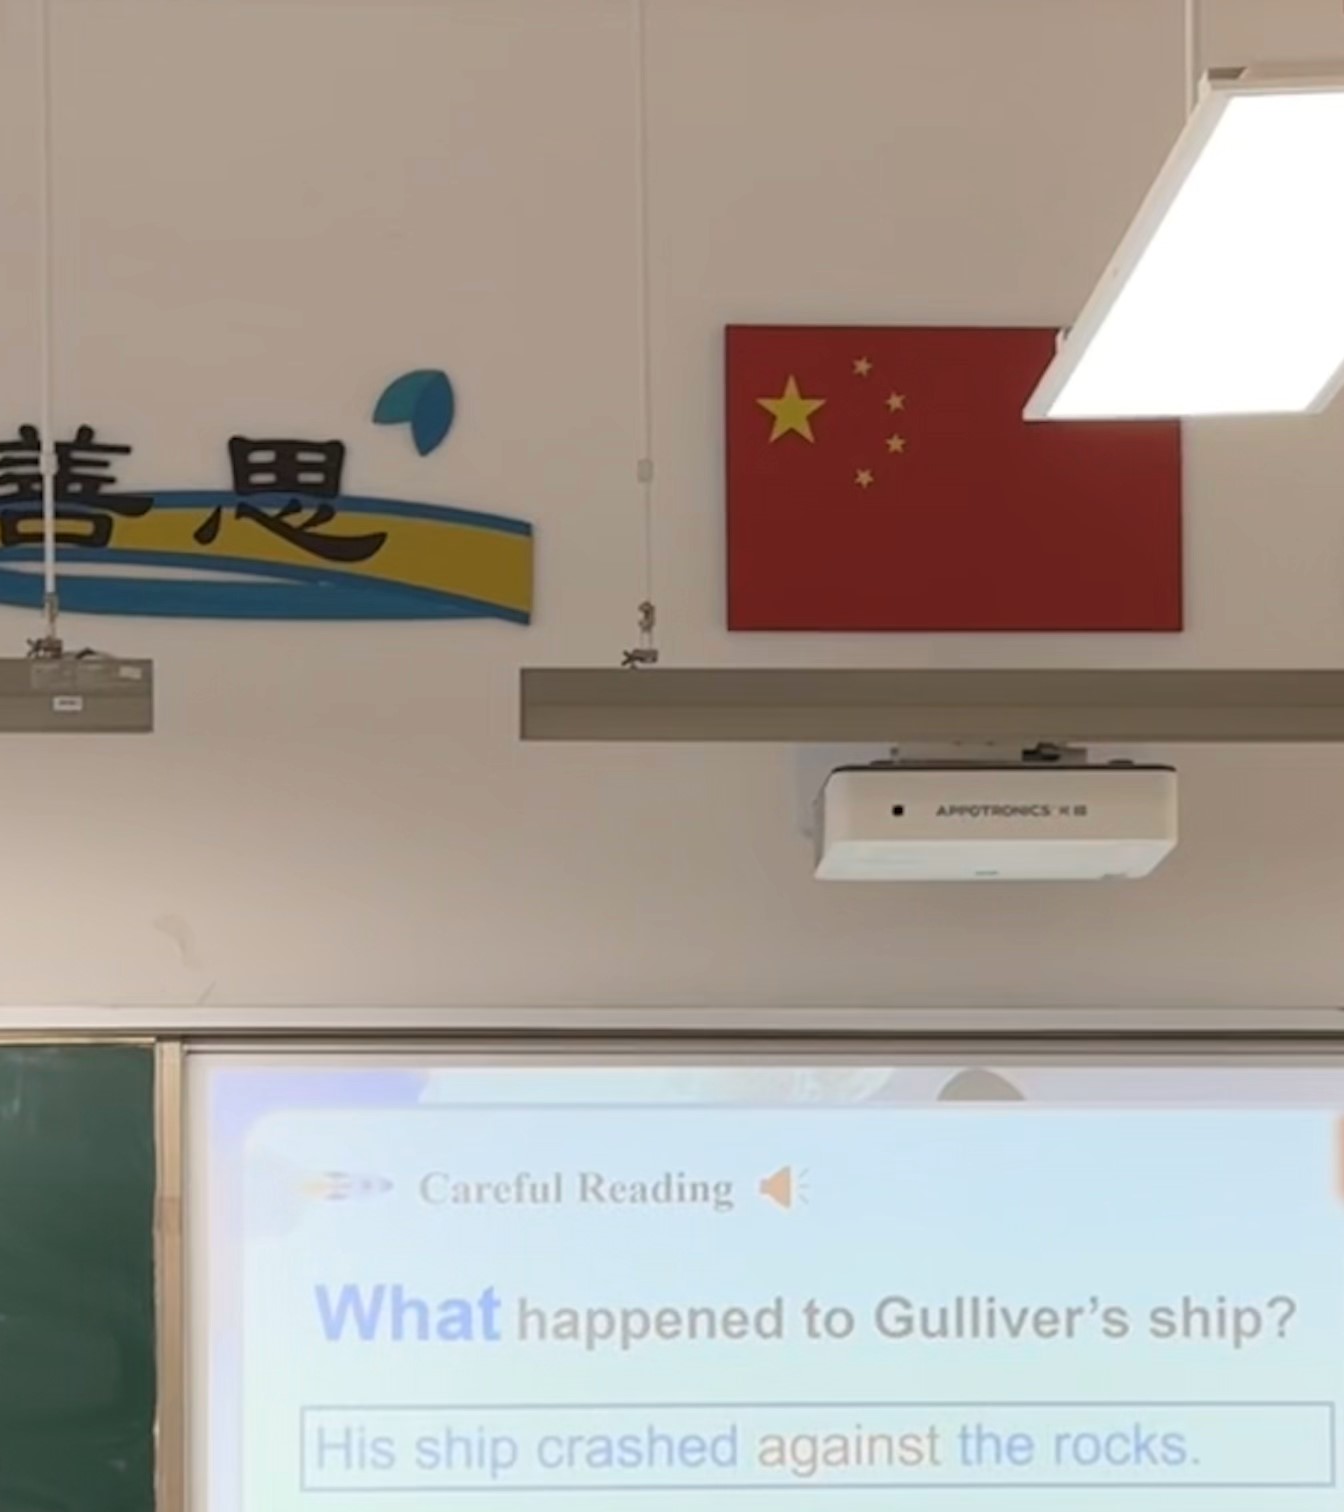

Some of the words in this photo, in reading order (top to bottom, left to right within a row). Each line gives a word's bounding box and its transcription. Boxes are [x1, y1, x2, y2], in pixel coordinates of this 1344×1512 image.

[418, 1170, 563, 1205] Careful
[577, 1170, 735, 1212] Reading
[313, 1282, 502, 1342] What
[517, 1296, 785, 1351] happened
[803, 1297, 855, 1339] to
[873, 1295, 1130, 1339] Gulliver’s
[1148, 1294, 1298, 1349] ship?
[315, 1424, 396, 1471] His
[414, 1424, 518, 1479] ship
[536, 1424, 739, 1469] crashed
[757, 1424, 941, 1477] against
[958, 1421, 1035, 1466] the
[1053, 1420, 1202, 1467] rocks.
